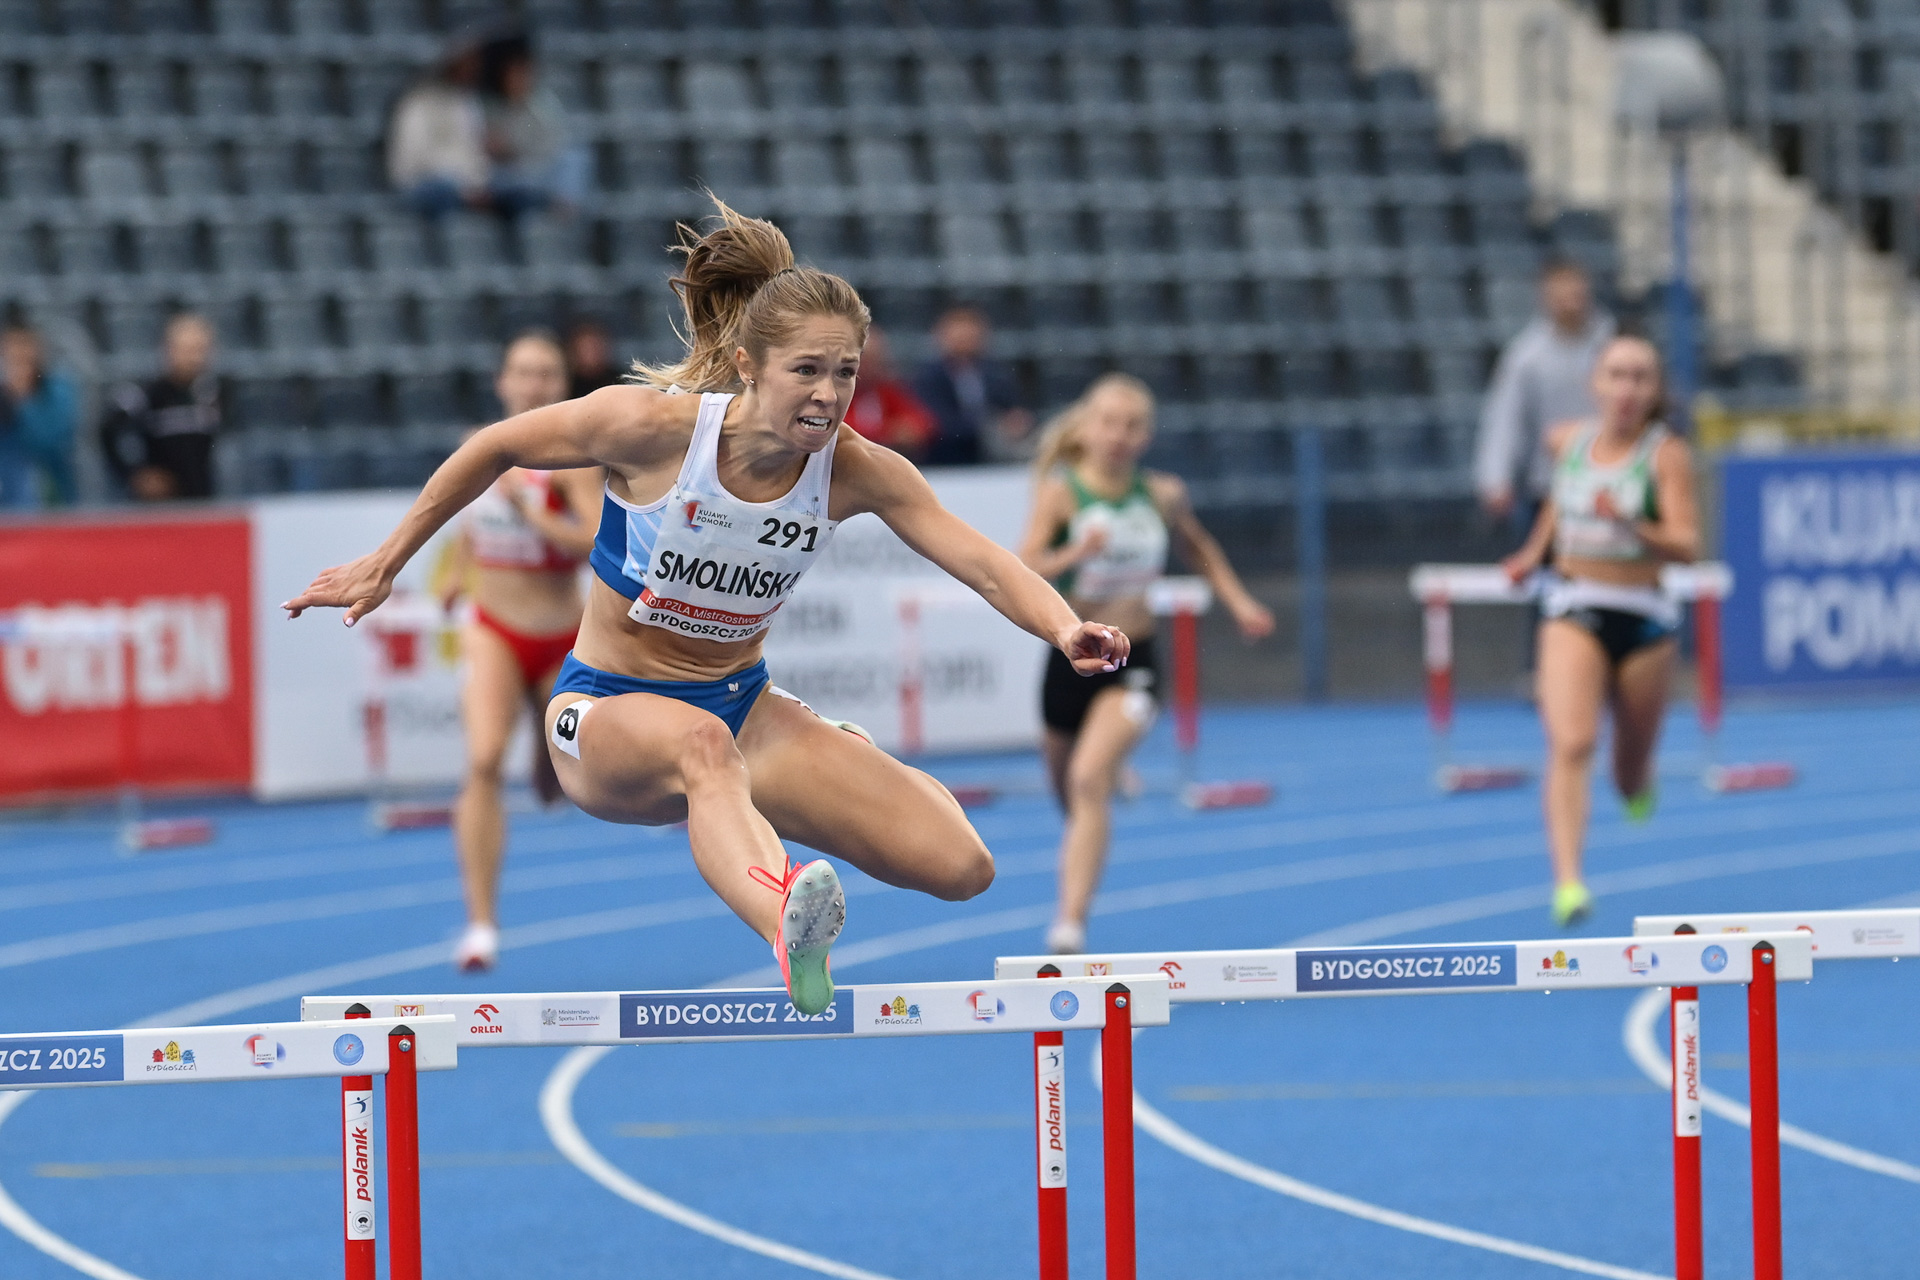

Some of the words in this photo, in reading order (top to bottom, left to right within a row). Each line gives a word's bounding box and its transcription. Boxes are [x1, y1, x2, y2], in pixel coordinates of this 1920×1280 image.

[697, 515, 733, 529] POMORZE
[698, 509, 728, 520] KUJAWY
[757, 517, 819, 552] 291
[655, 550, 801, 599] SMOLIŃSKA
[664, 600, 691, 616] PZLA
[693, 609, 756, 625] Mistrzostwa
[649, 612, 738, 639] BYDGOSZCZ
[1311, 957, 1445, 981] BYDGOSZCZ
[1450, 955, 1502, 977] 2025
[1168, 981, 1186, 990] LEN
[636, 1002, 777, 1026] BYDGOSZCZ
[874, 1017, 922, 1026] BYDGOSZCZ
[470, 1025, 503, 1034] ORLEN
[48, 1047, 106, 1070] 2025
[146, 1063, 197, 1072] BYDGOSZCZ
[1684, 1034, 1699, 1101] polanik
[1045, 1080, 1063, 1151] polanik
[351, 1126, 372, 1202] polanik
